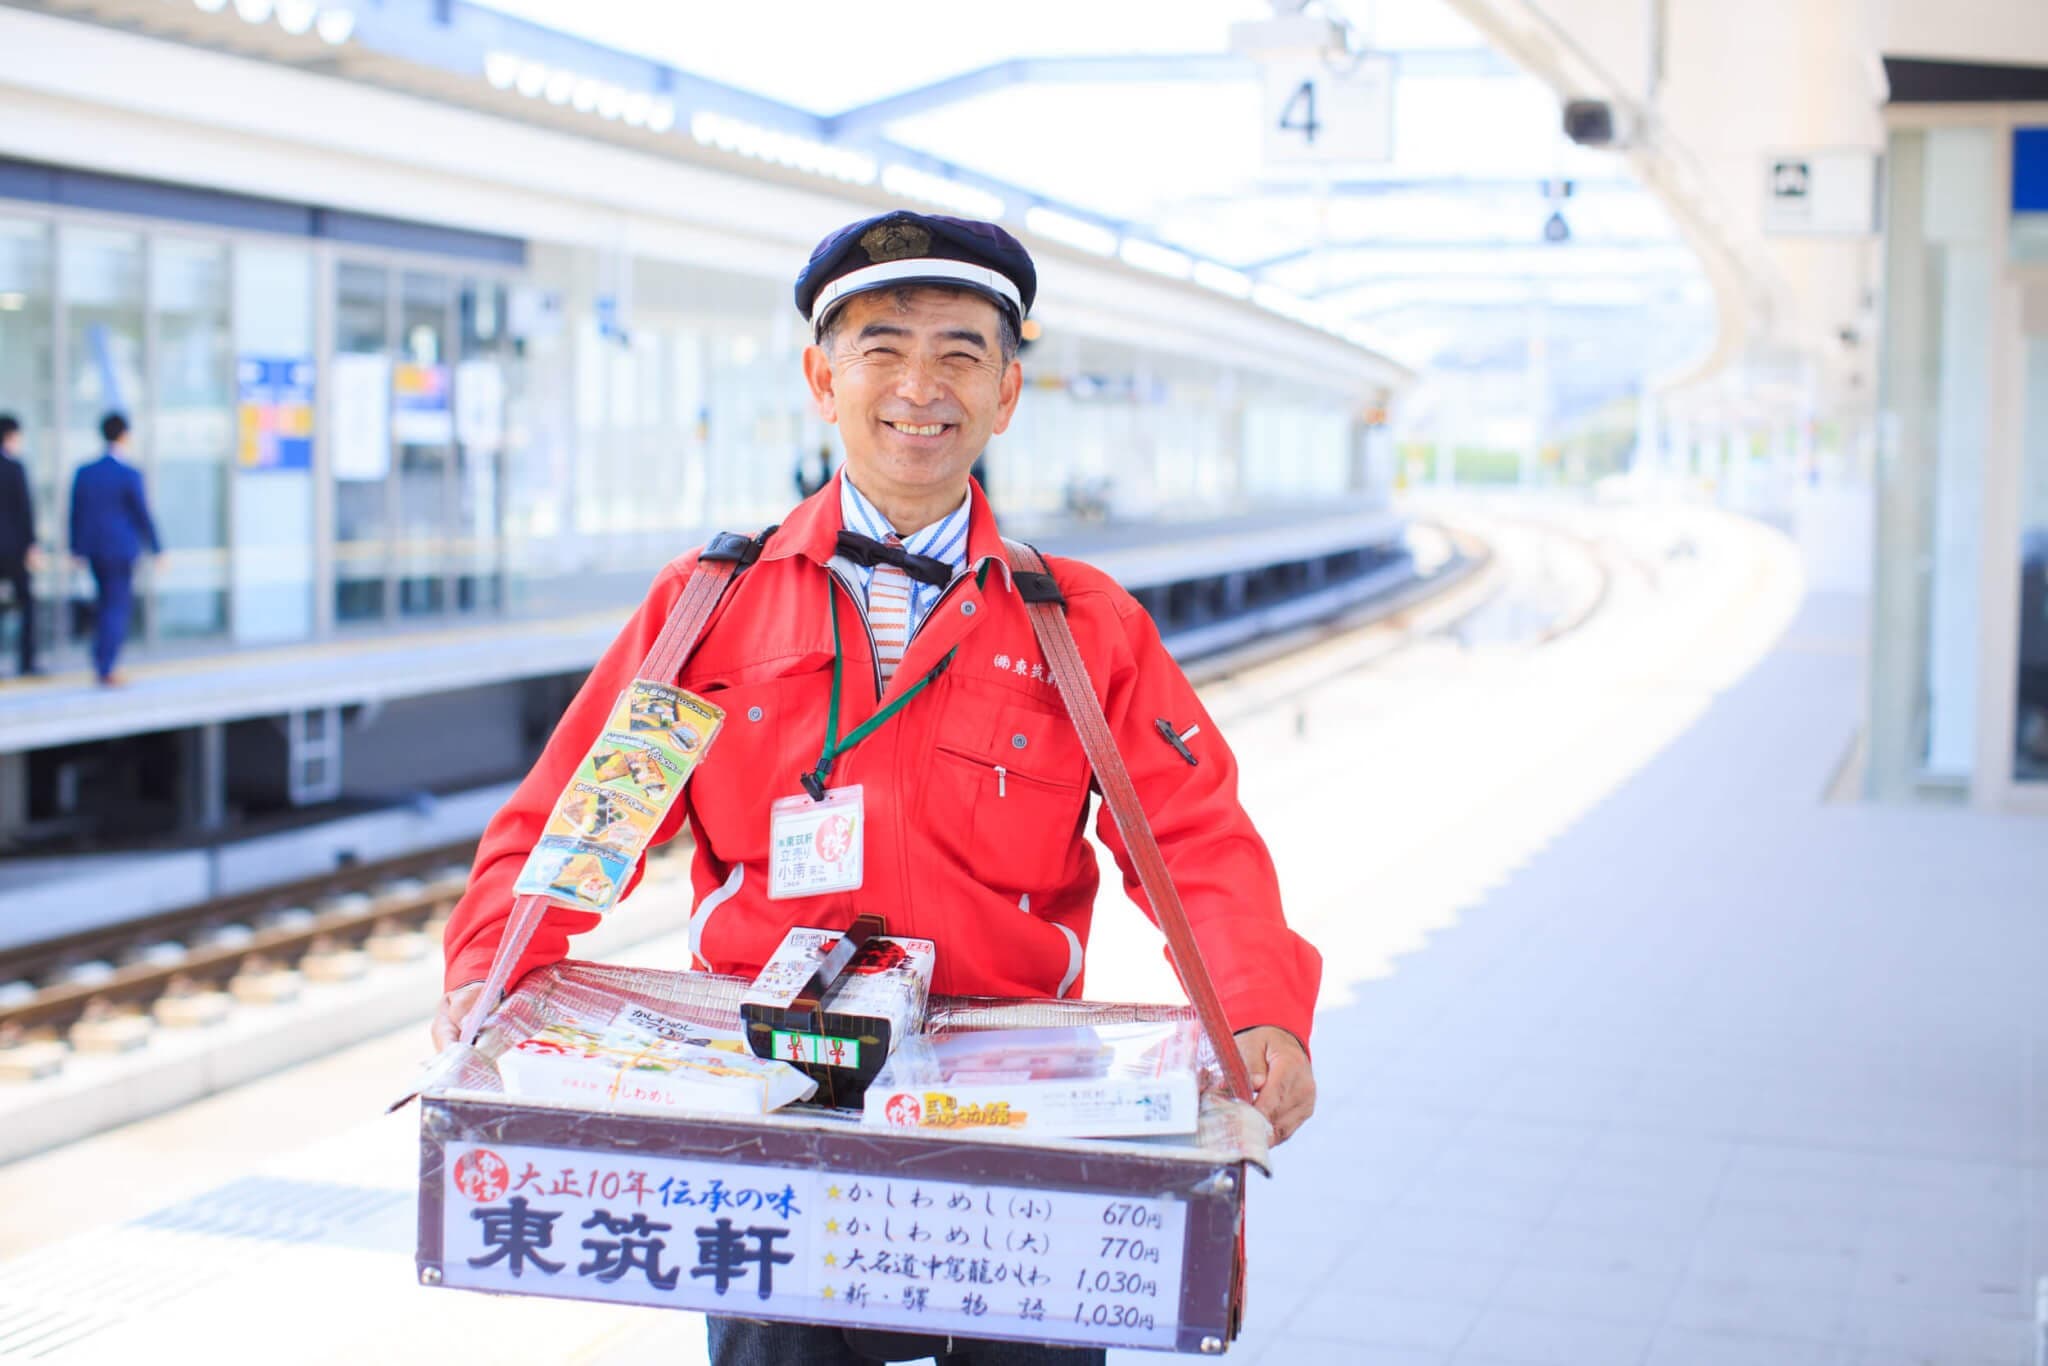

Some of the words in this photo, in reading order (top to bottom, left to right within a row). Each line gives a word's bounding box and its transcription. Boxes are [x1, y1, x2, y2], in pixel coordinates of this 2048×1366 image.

[1280, 82, 1321, 143] 4
[1103, 1202, 1161, 1229] 670円
[467, 1195, 795, 1299] 東筑軒
[1099, 1237, 1160, 1264] 770円
